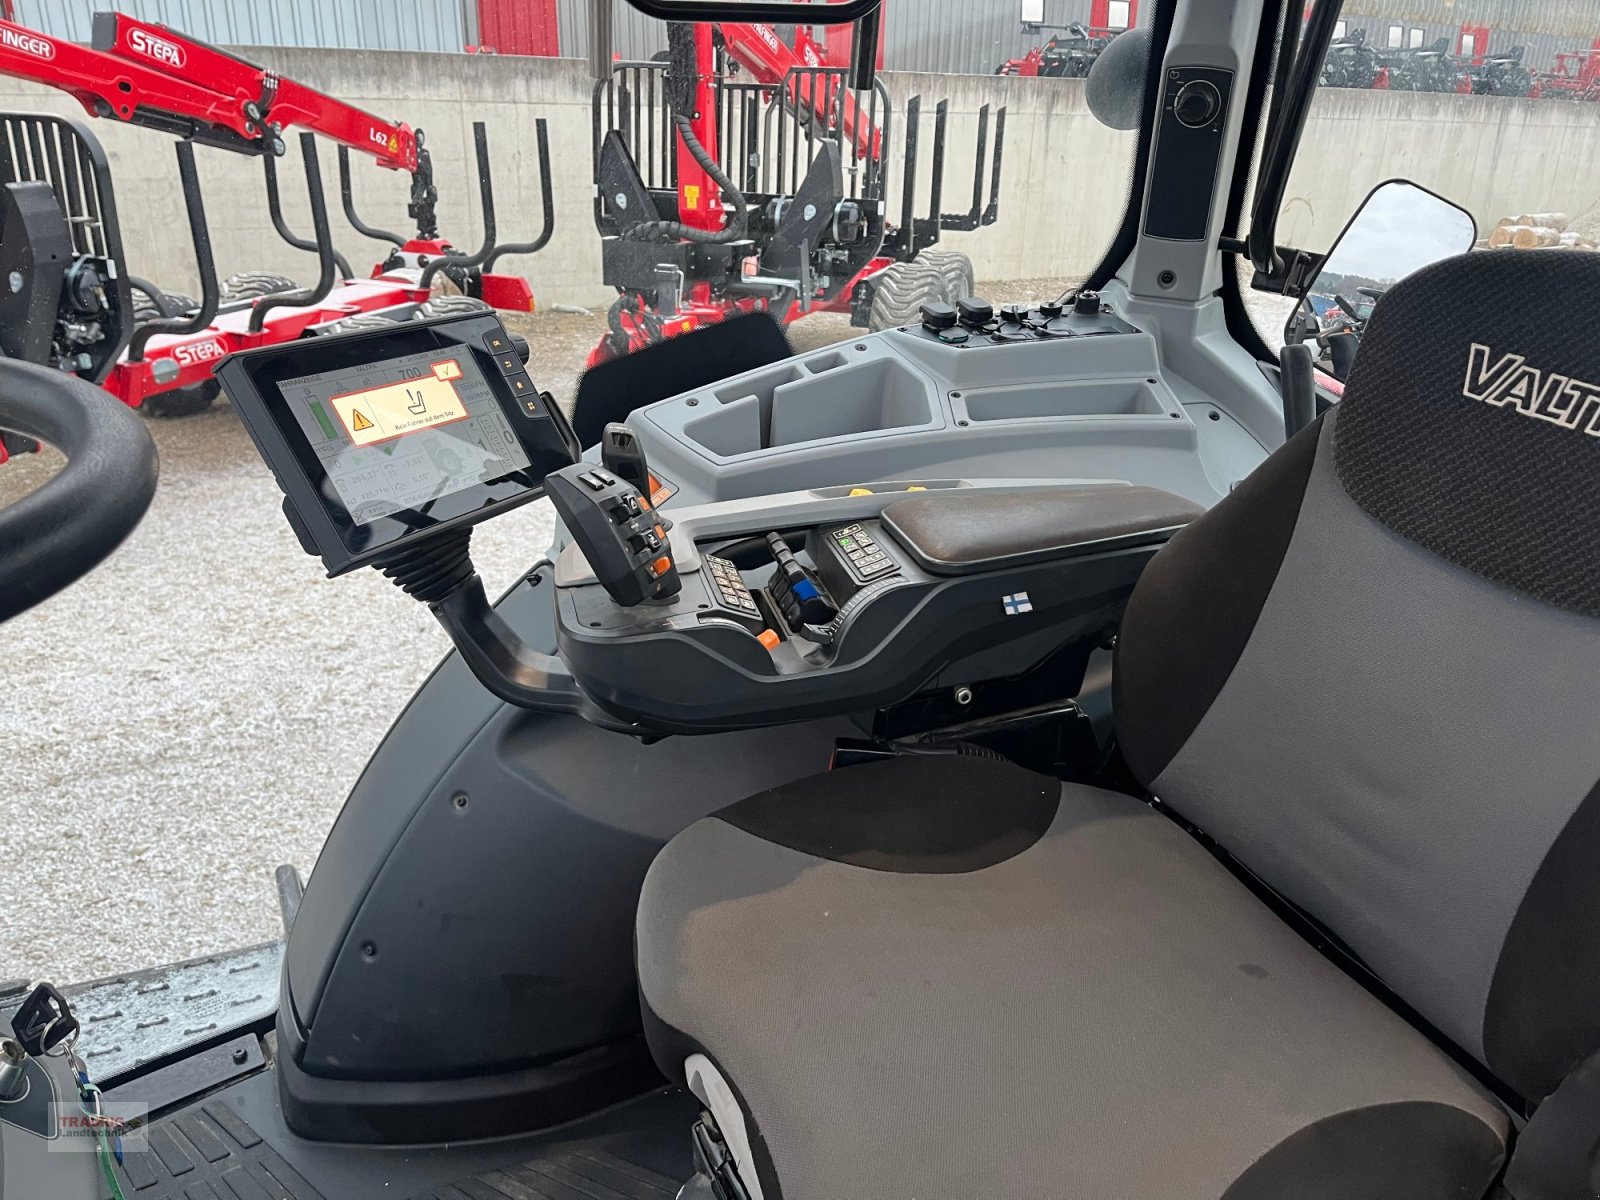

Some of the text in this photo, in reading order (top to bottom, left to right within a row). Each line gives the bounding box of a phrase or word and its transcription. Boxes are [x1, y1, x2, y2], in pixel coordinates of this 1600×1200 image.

[132, 30, 180, 66] STEPA
[370, 127, 387, 147] L62
[175, 340, 224, 365] STEPA
[398, 367, 421, 380] 700
[503, 430, 514, 444] 0
